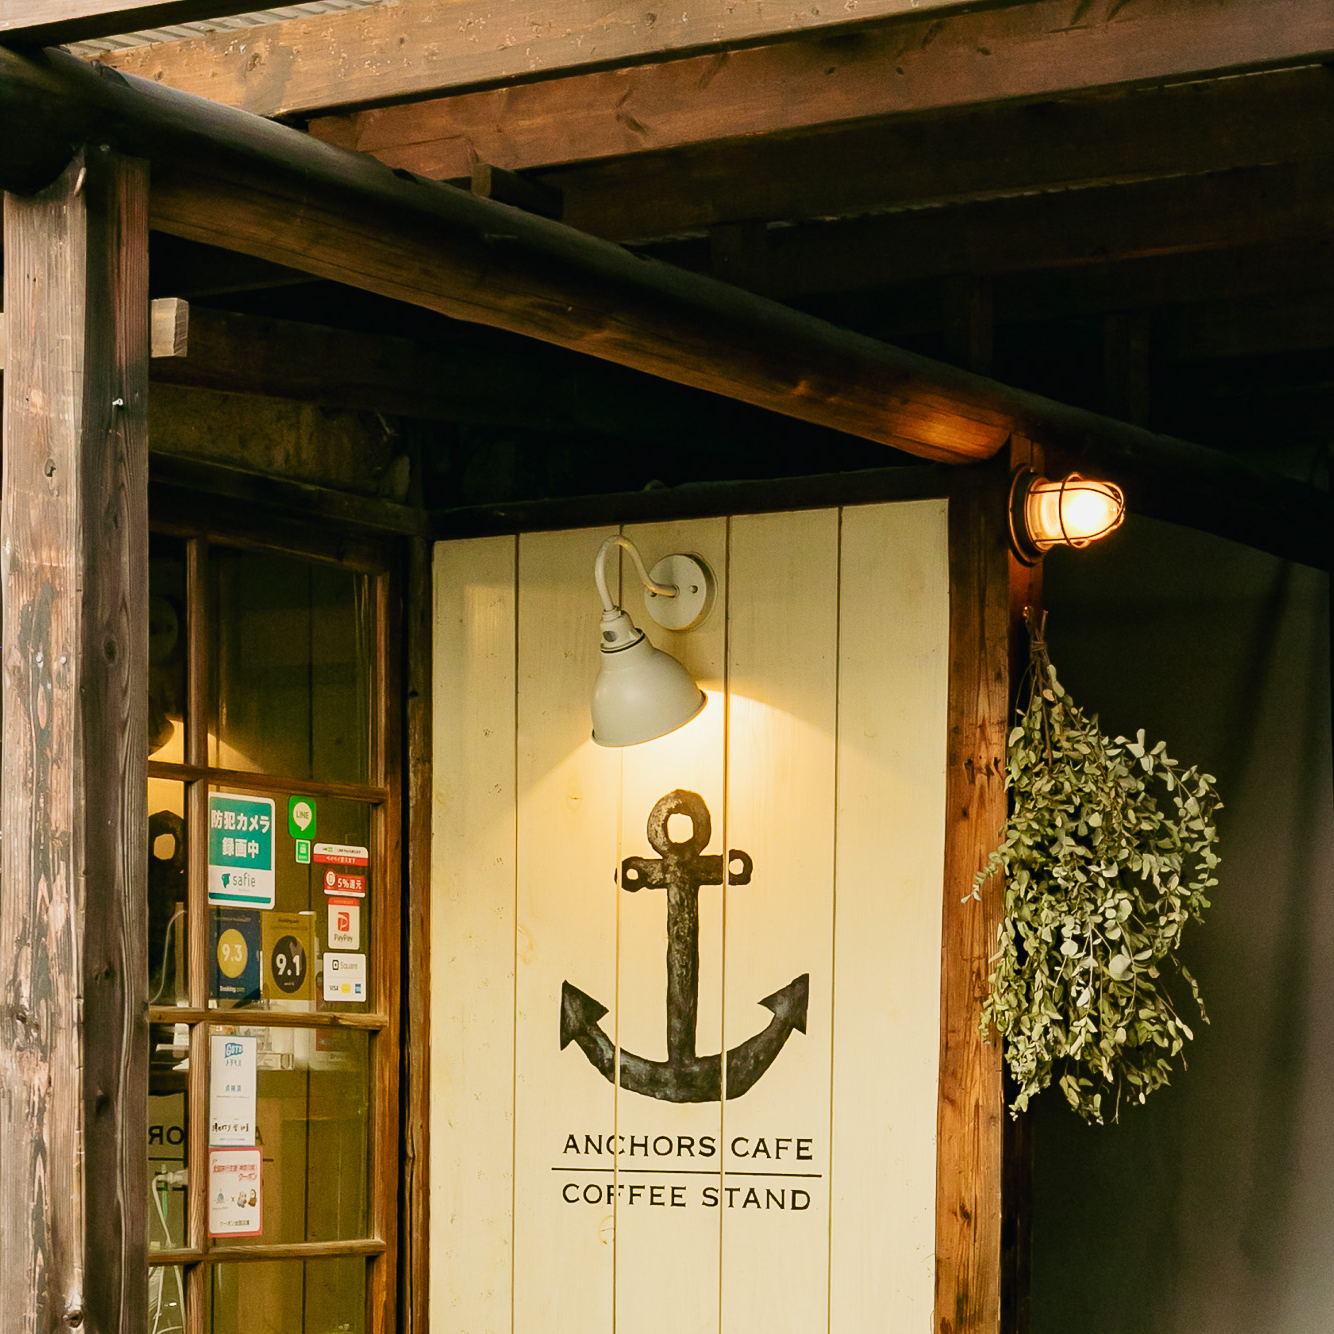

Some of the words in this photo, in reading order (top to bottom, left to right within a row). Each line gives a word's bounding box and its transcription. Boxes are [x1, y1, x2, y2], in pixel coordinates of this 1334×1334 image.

[210, 809, 271, 834] 防犯カメラ
[295, 809, 310, 820] LINE
[221, 837, 260, 859] 録画中
[232, 872, 256, 888] safie
[333, 933, 354, 943] PayPay
[221, 943, 243, 962] 9.3
[275, 953, 301, 977] 9.1
[339, 960, 359, 971] Square
[562, 1133, 716, 1158] ANCHORS
[730, 1136, 814, 1161] CAFE
[562, 1183, 688, 1208] COFFEE
[701, 1186, 812, 1211] STAND
